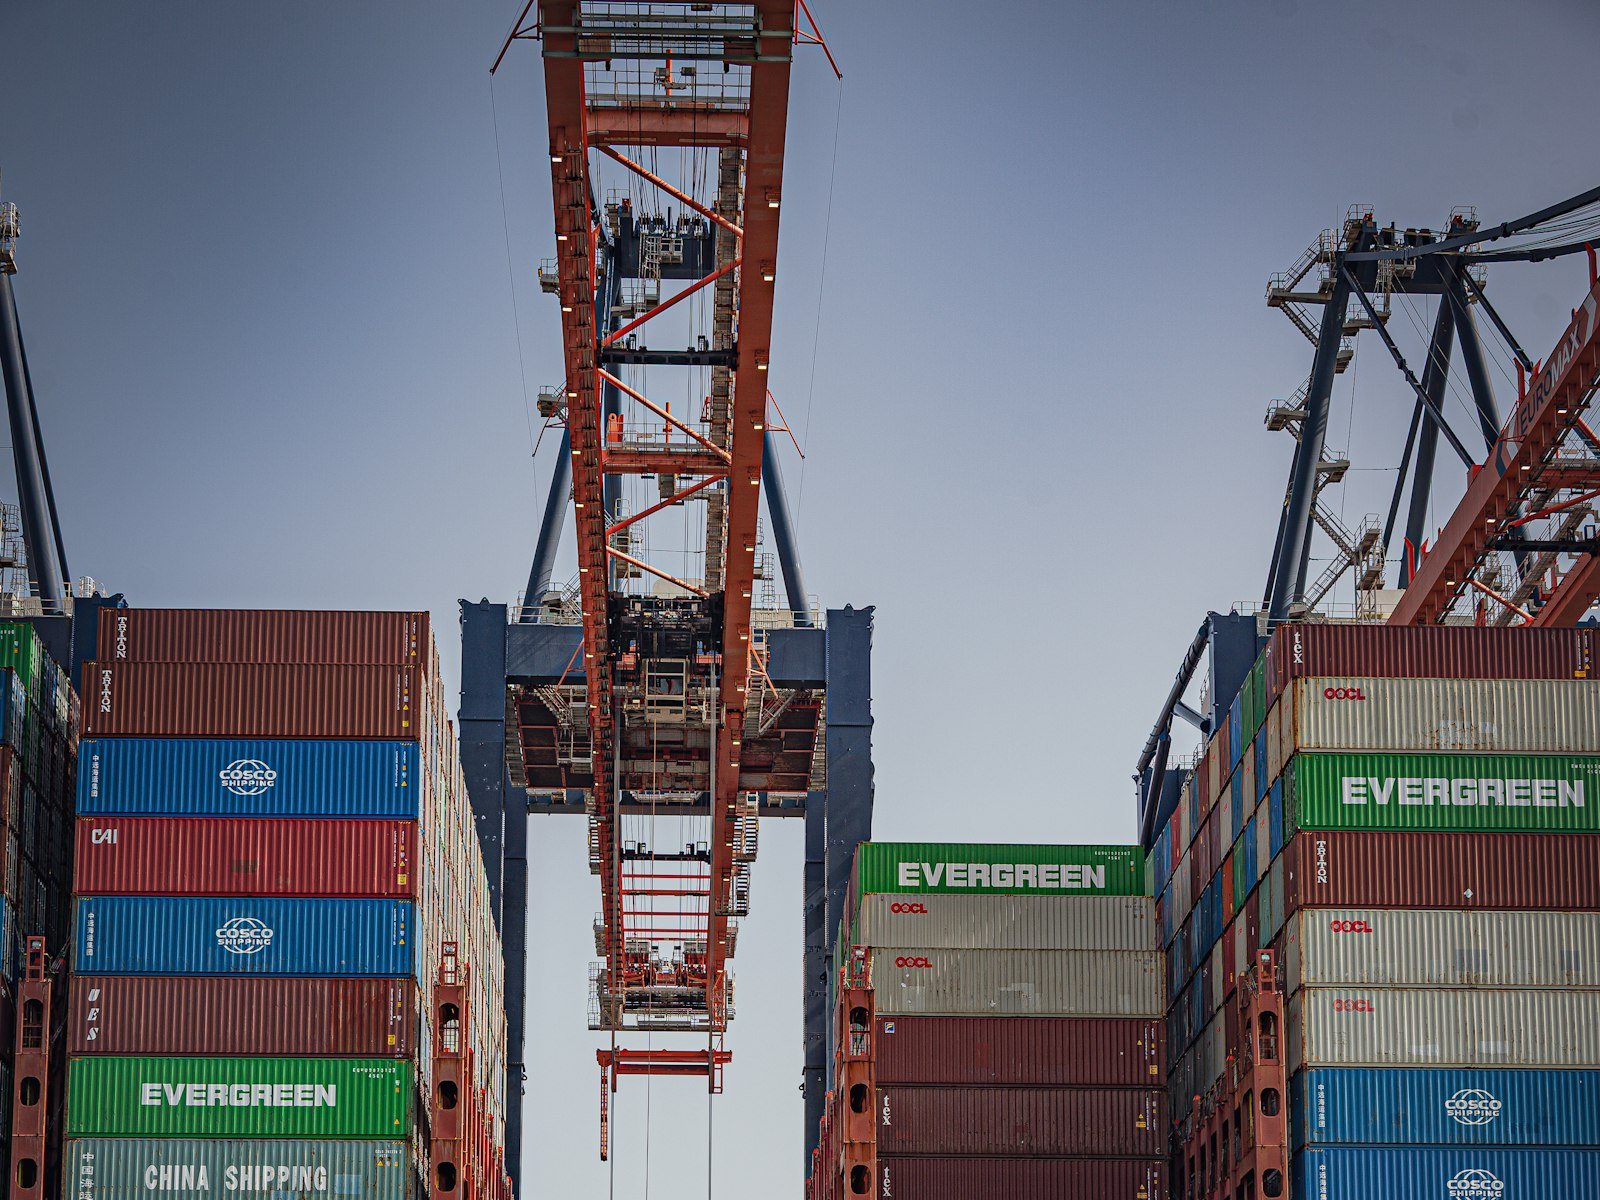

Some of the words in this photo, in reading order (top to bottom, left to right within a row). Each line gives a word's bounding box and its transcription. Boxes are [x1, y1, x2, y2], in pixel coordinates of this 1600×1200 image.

[1519, 320, 1581, 436] EUROMAX
[117, 616, 127, 659] TRITON
[1293, 631, 1303, 664] tex
[101, 669, 112, 713] TRITON
[1324, 687, 1366, 701] OOCL
[219, 769, 277, 780] COSCO
[1342, 776, 1585, 808] EVERGREEN
[92, 828, 118, 844] CAI
[1316, 840, 1327, 884] TRITON
[898, 862, 1105, 889] EVERGREEN
[890, 902, 928, 914] OOCL
[215, 928, 274, 939] COSCO
[1331, 919, 1373, 933] OOCL
[217, 938, 271, 946] SHIPPING
[895, 956, 933, 969] OOCL
[1332, 999, 1375, 1012] OOCL
[141, 1082, 337, 1107] EVERGREEN
[882, 1094, 891, 1125] tex
[1445, 1099, 1502, 1110] COSCO
[144, 1165, 209, 1190] CHINA
[225, 1165, 327, 1191] SHIPPING
[882, 1166, 891, 1197] tex
[1446, 1179, 1505, 1190] COSCO
[1448, 1190, 1502, 1198] SHIPPING
